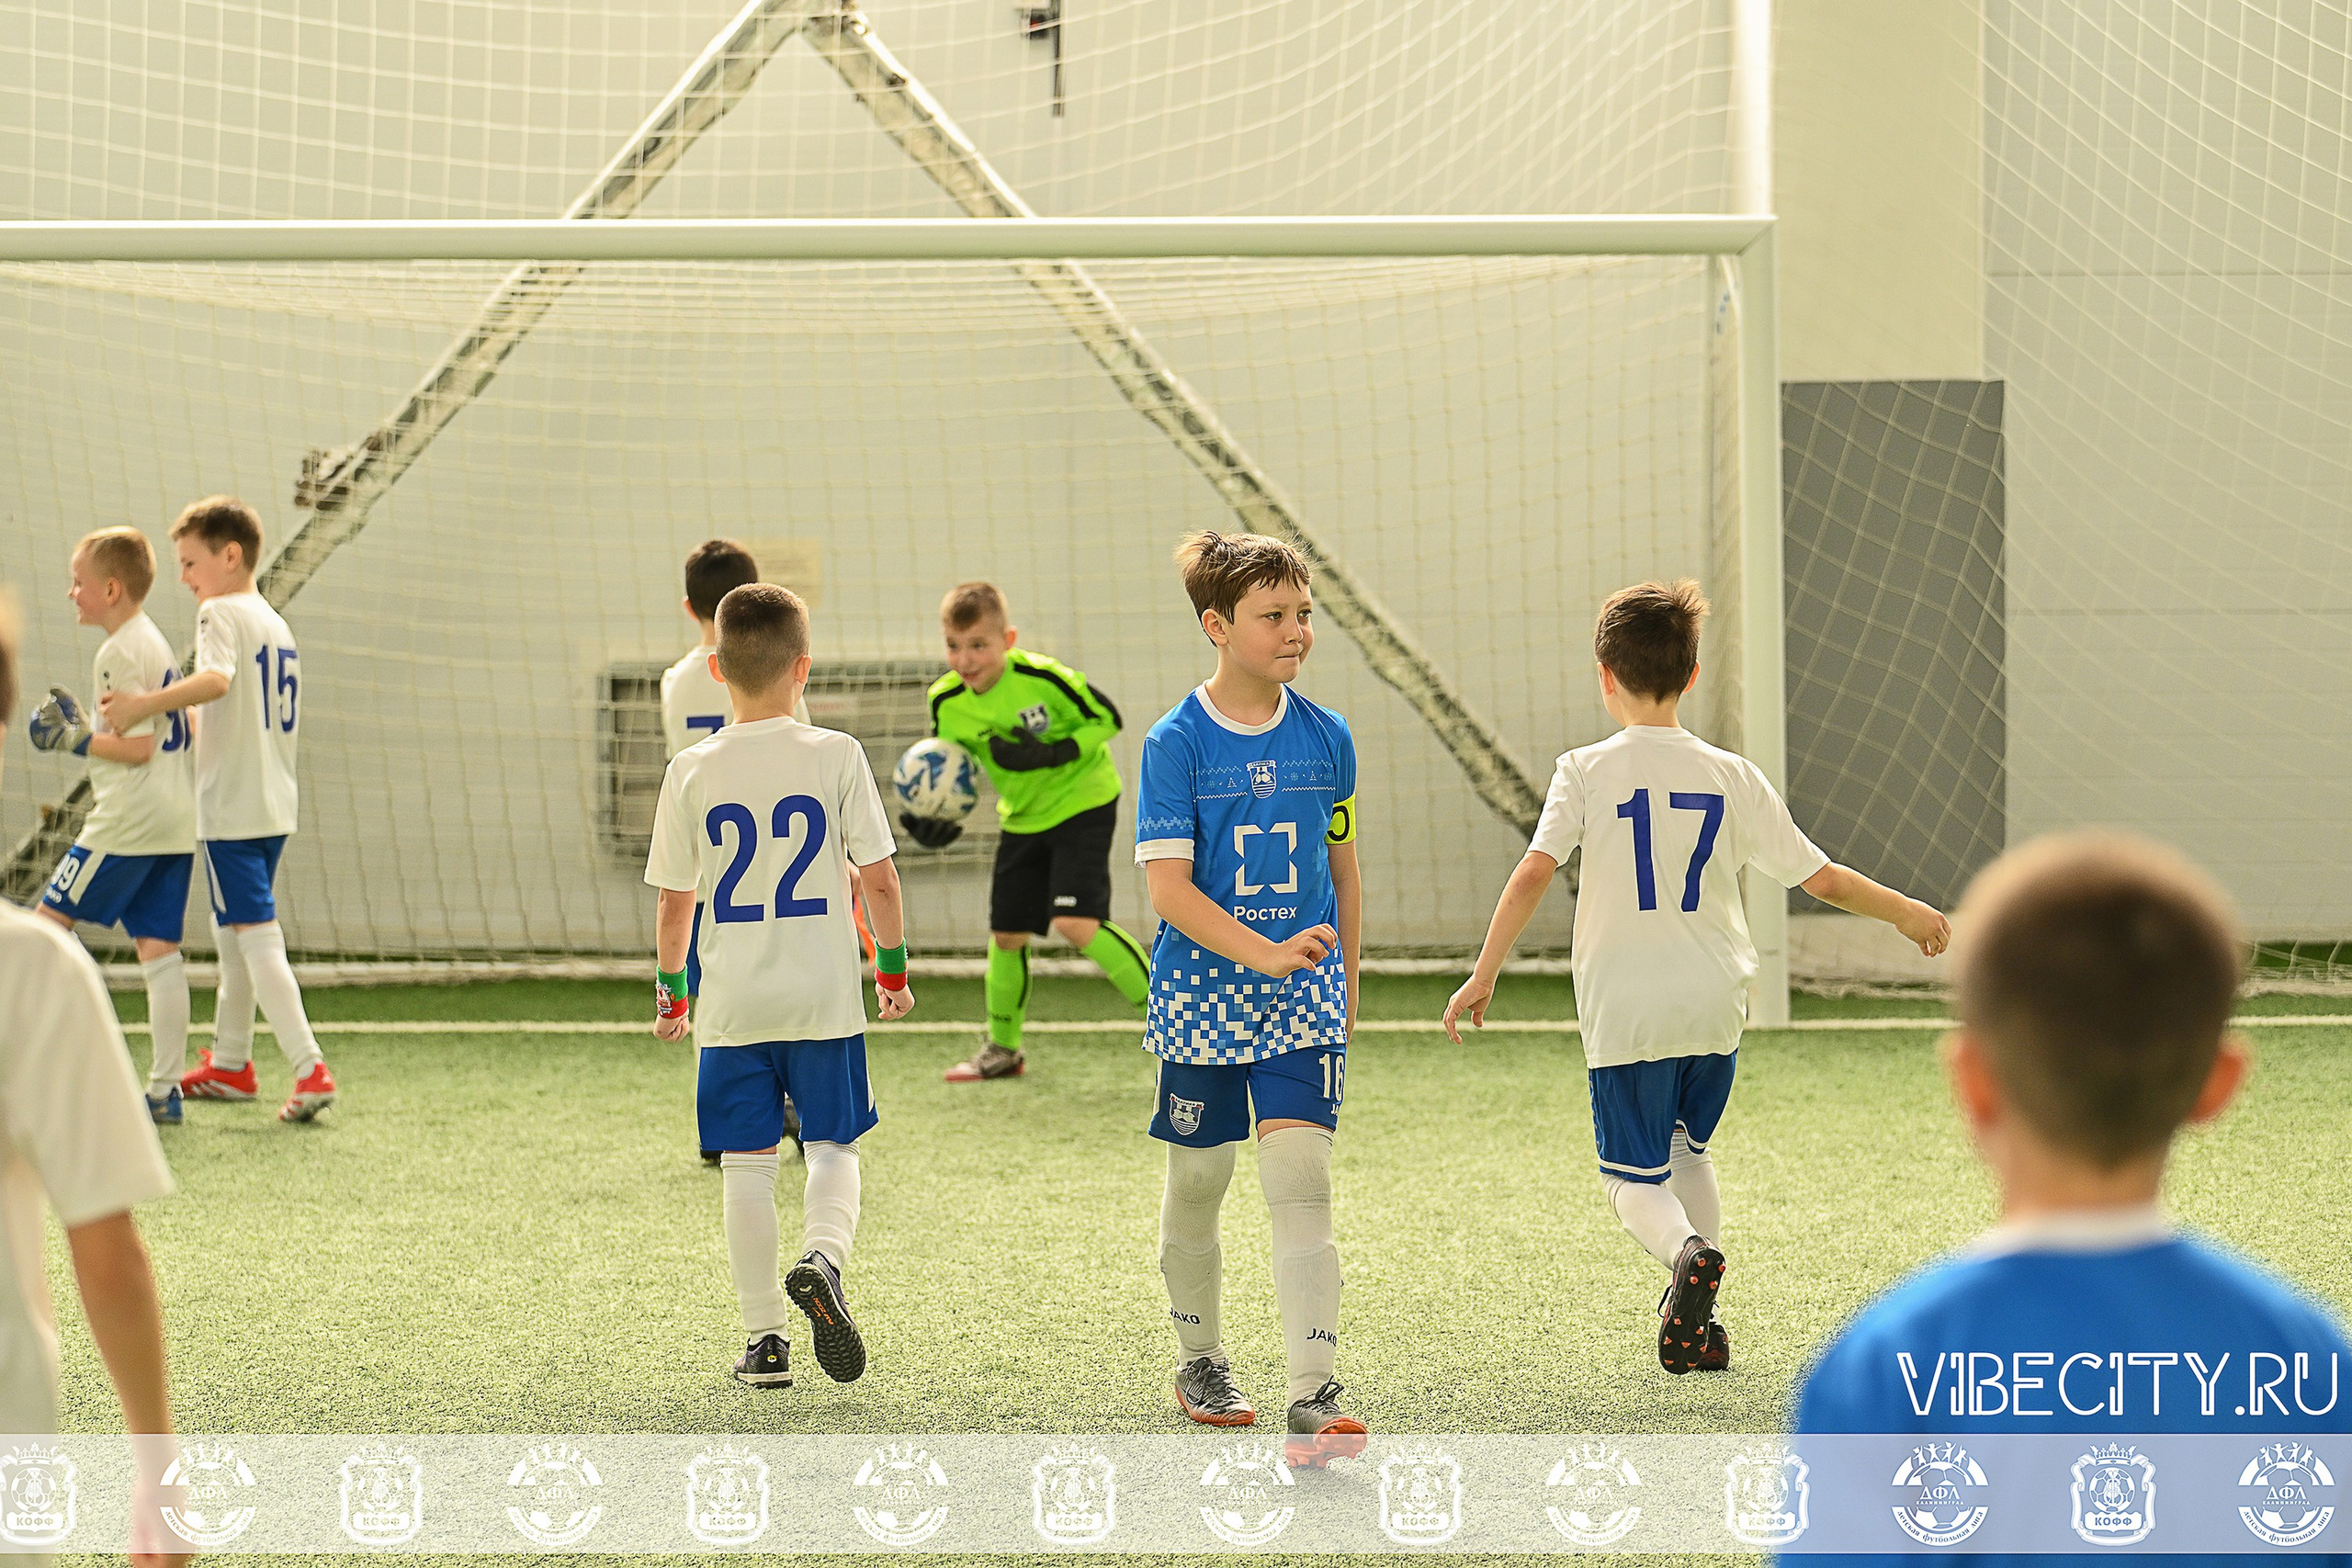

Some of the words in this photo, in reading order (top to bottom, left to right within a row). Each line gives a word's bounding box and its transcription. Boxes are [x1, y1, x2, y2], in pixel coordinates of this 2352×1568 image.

[255, 644, 298, 733] 15
[705, 794, 828, 924] 22
[1616, 787, 1724, 913] 17
[1233, 905, 1297, 921] Ростех
[1318, 1053, 1344, 1101] 16
[1306, 1327, 1337, 1347] JAKO
